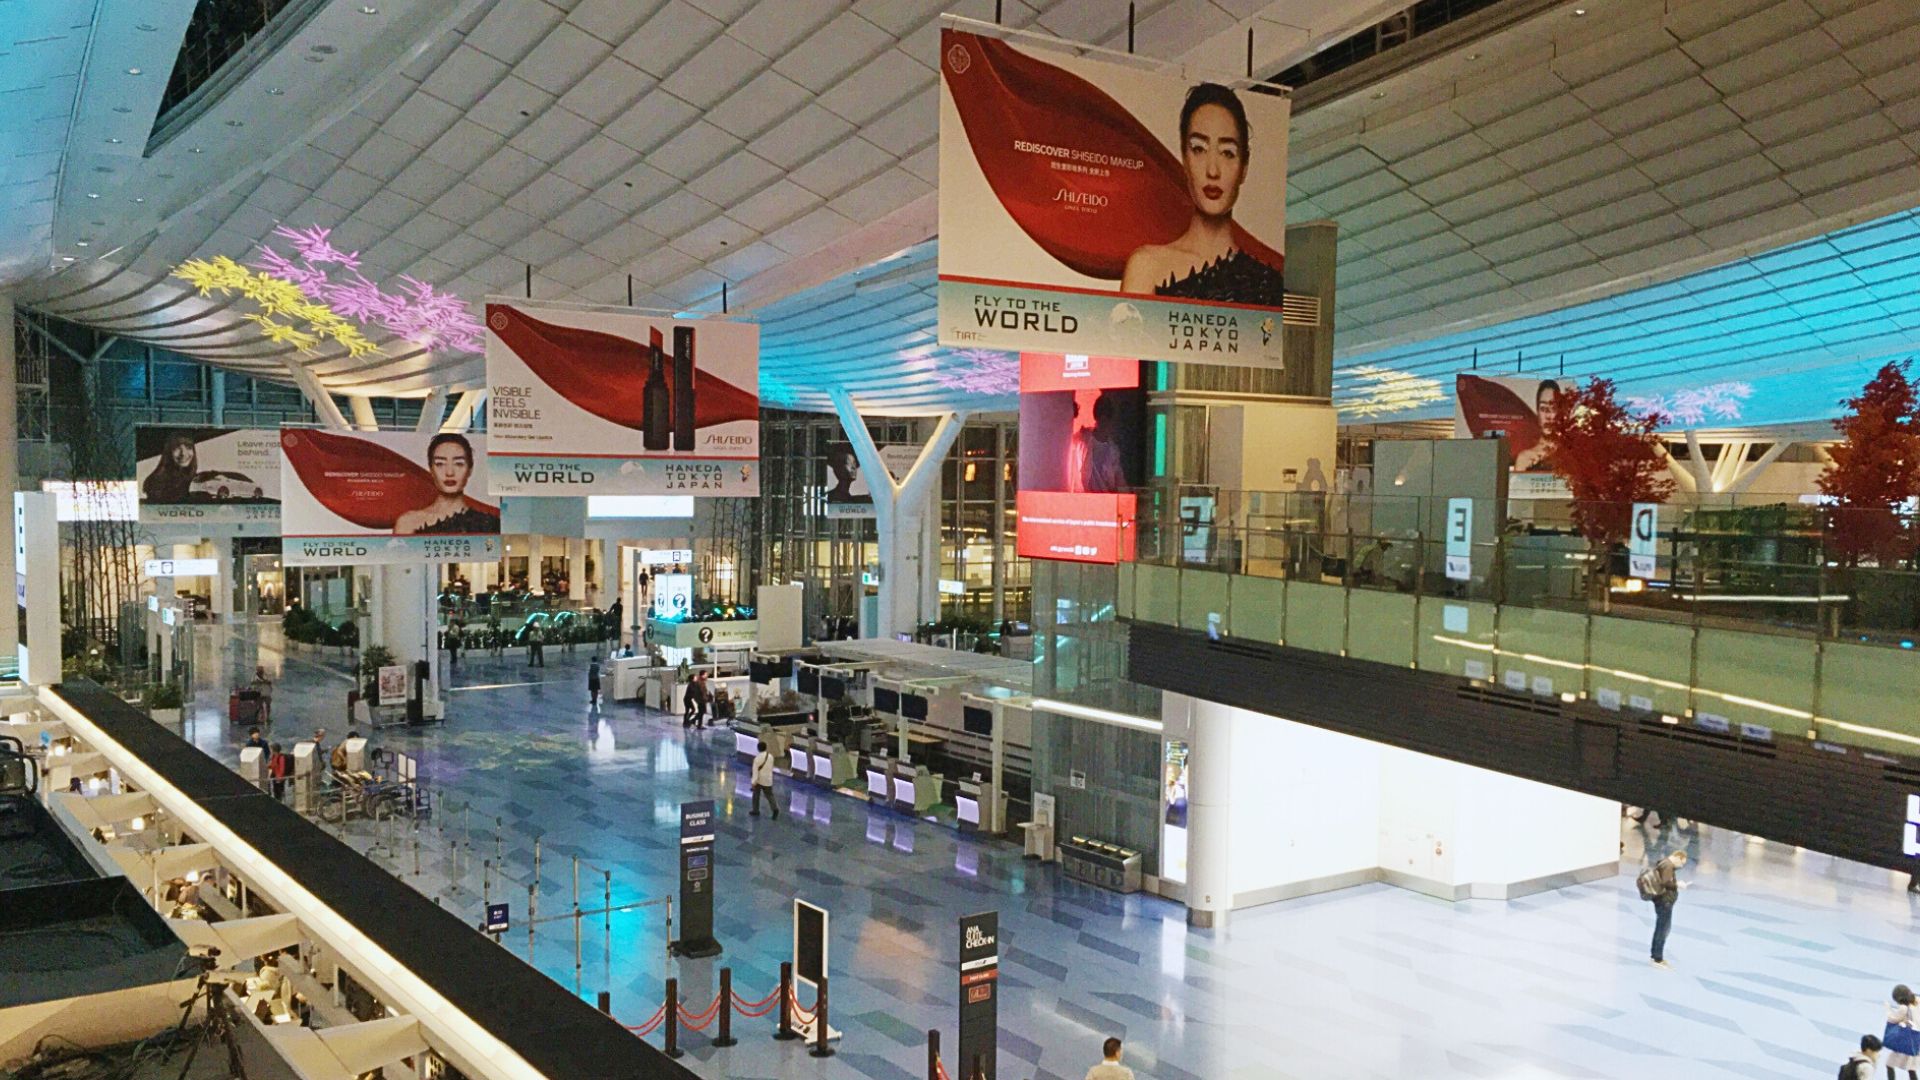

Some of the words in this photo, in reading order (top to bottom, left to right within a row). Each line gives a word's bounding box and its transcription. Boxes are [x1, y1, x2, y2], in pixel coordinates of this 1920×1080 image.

[1014, 140, 1070, 158] REDISCOVER
[1071, 149, 1108, 165] SHISEIDO
[1110, 156, 1144, 170] MAKEUP
[1052, 188, 1109, 207] SHISEIDO
[975, 295, 1001, 307] FLY
[1006, 298, 1026, 309] TO
[1032, 300, 1060, 312] THE
[975, 308, 1078, 334] WORLD
[1169, 310, 1238, 327] HANEDA
[1169, 324, 1238, 341] TOKYO
[1169, 338, 1238, 353] JAPAN
[492, 386, 532, 397] VISIBLE
[493, 397, 526, 408] FEELS
[493, 408, 541, 420] INVISIBLE
[703, 434, 753, 445] SHISEIDO
[539, 463, 554, 471] TO
[558, 463, 581, 471] THE
[666, 464, 722, 473] HANEDA
[514, 471, 595, 484] WORLD
[666, 472, 723, 481] TOKYO
[666, 481, 722, 489] JAPAN
[304, 547, 367, 557] WORLD
[685, 811, 710, 820] BUSINESS
[689, 819, 706, 827] CLASS
